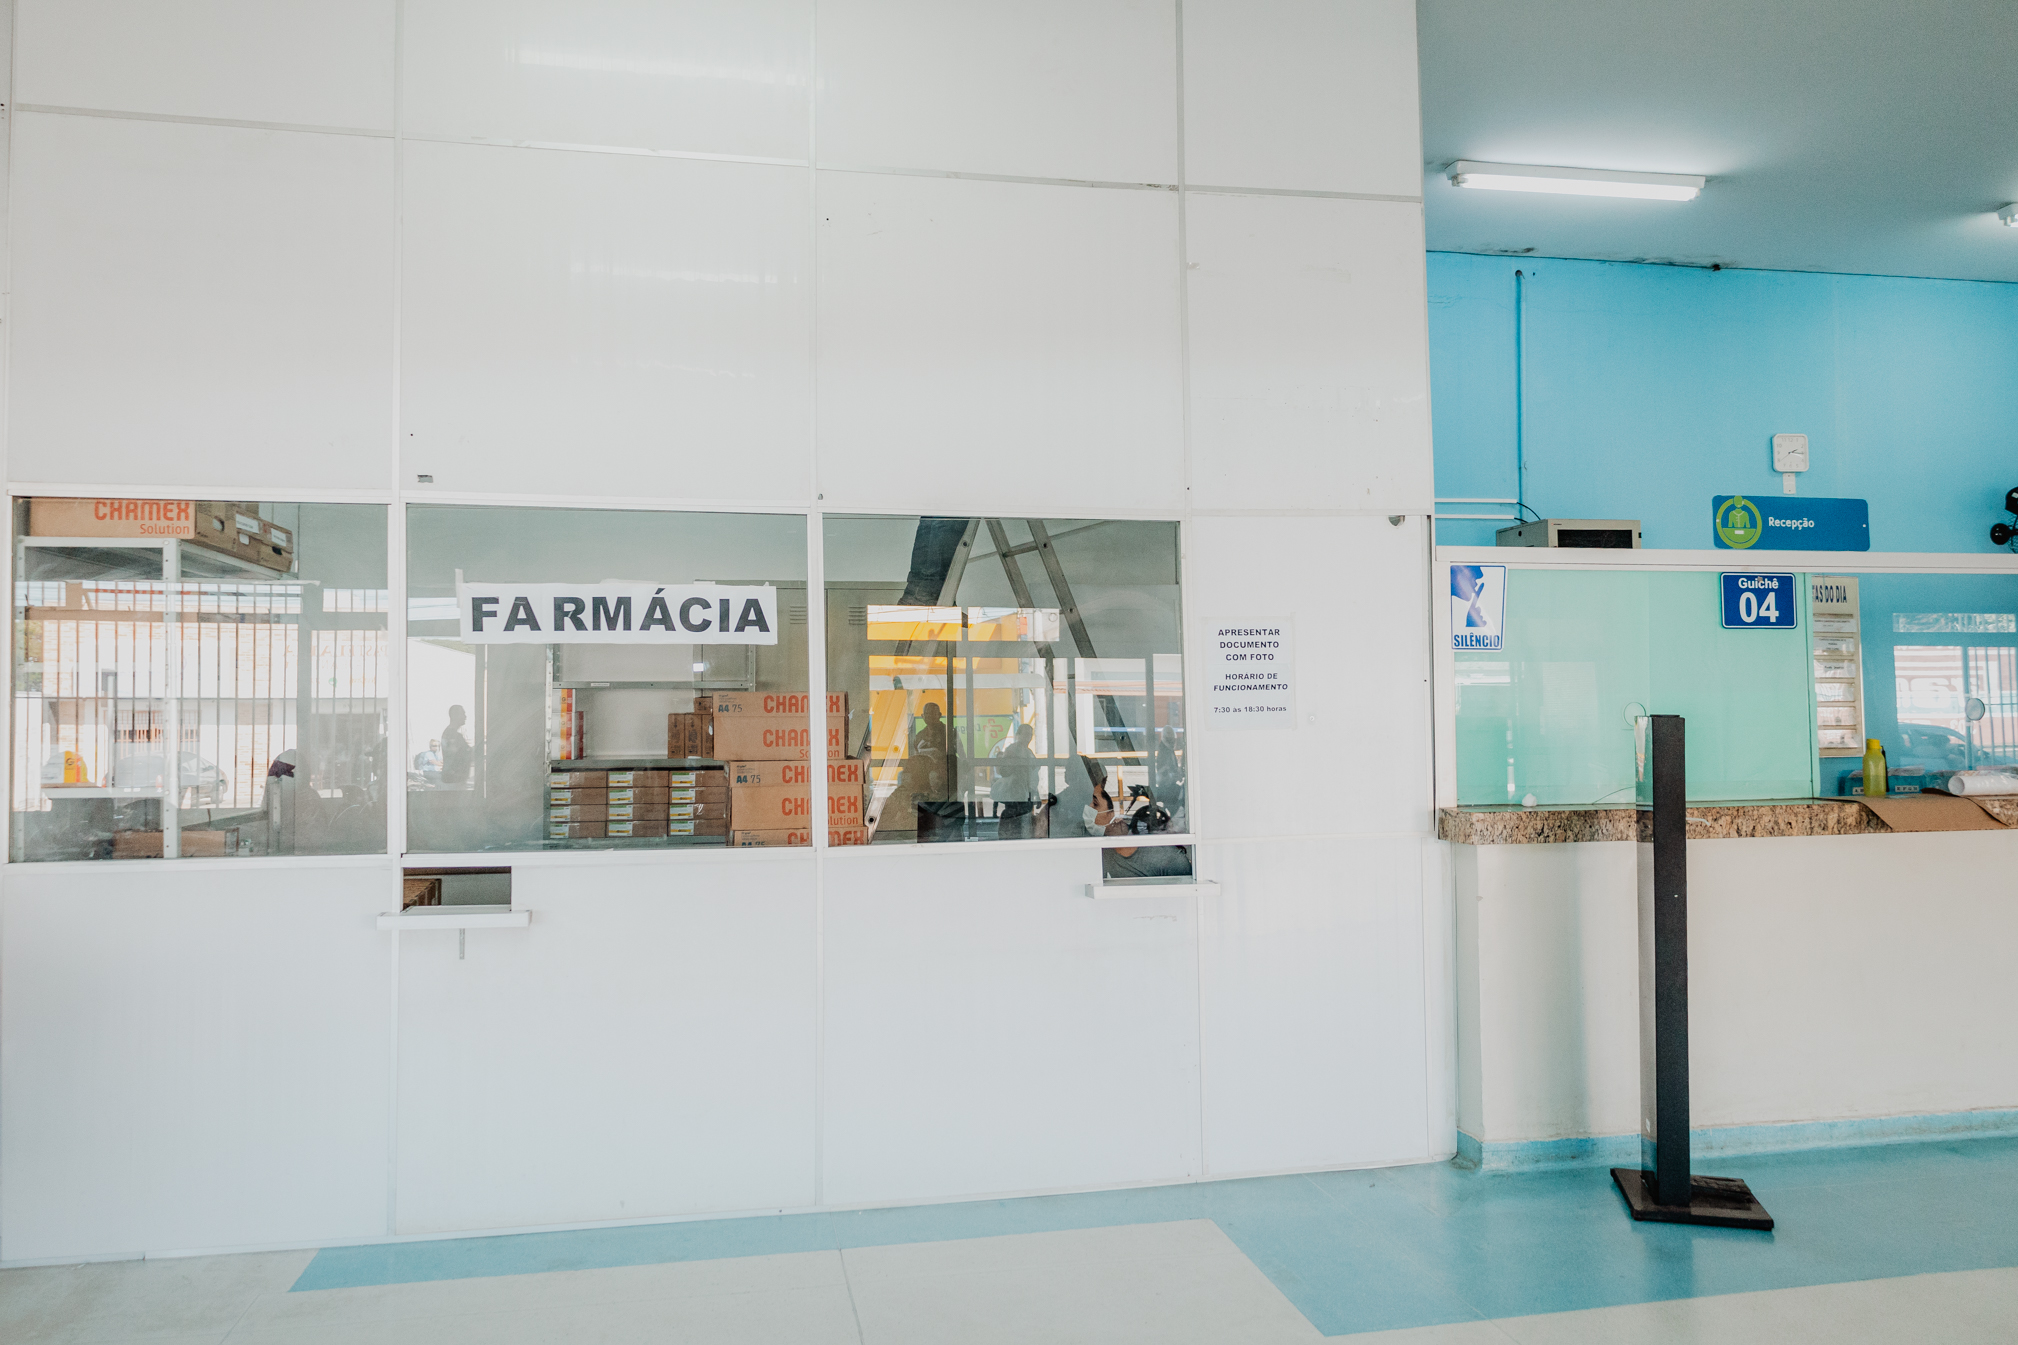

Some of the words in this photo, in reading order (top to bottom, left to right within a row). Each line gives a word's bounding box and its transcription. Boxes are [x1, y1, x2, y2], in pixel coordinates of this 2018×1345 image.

[94, 501, 190, 521] CHAMEX
[139, 523, 190, 534] Solution
[1768, 517, 1815, 530] Recepção
[1738, 577, 1779, 589] Guichê
[1824, 585, 1834, 603] DO
[1836, 585, 1848, 604] DIA
[471, 588, 770, 633] FARMÁCIA
[1739, 591, 1779, 623] 04
[1218, 628, 1280, 636] APRESENTAR
[1219, 641, 1279, 649] DOCUMENTO
[1453, 632, 1500, 647] SILÊNCIO
[1225, 653, 1247, 661] COM
[1250, 653, 1274, 661] FOTO
[1225, 672, 1264, 680] HORÁRIO
[1213, 683, 1288, 691] FUNCIONAMENTO
[718, 704, 729, 713] A4
[732, 704, 743, 713] 75
[736, 775, 748, 783] A4
[750, 774, 761, 784] 75
